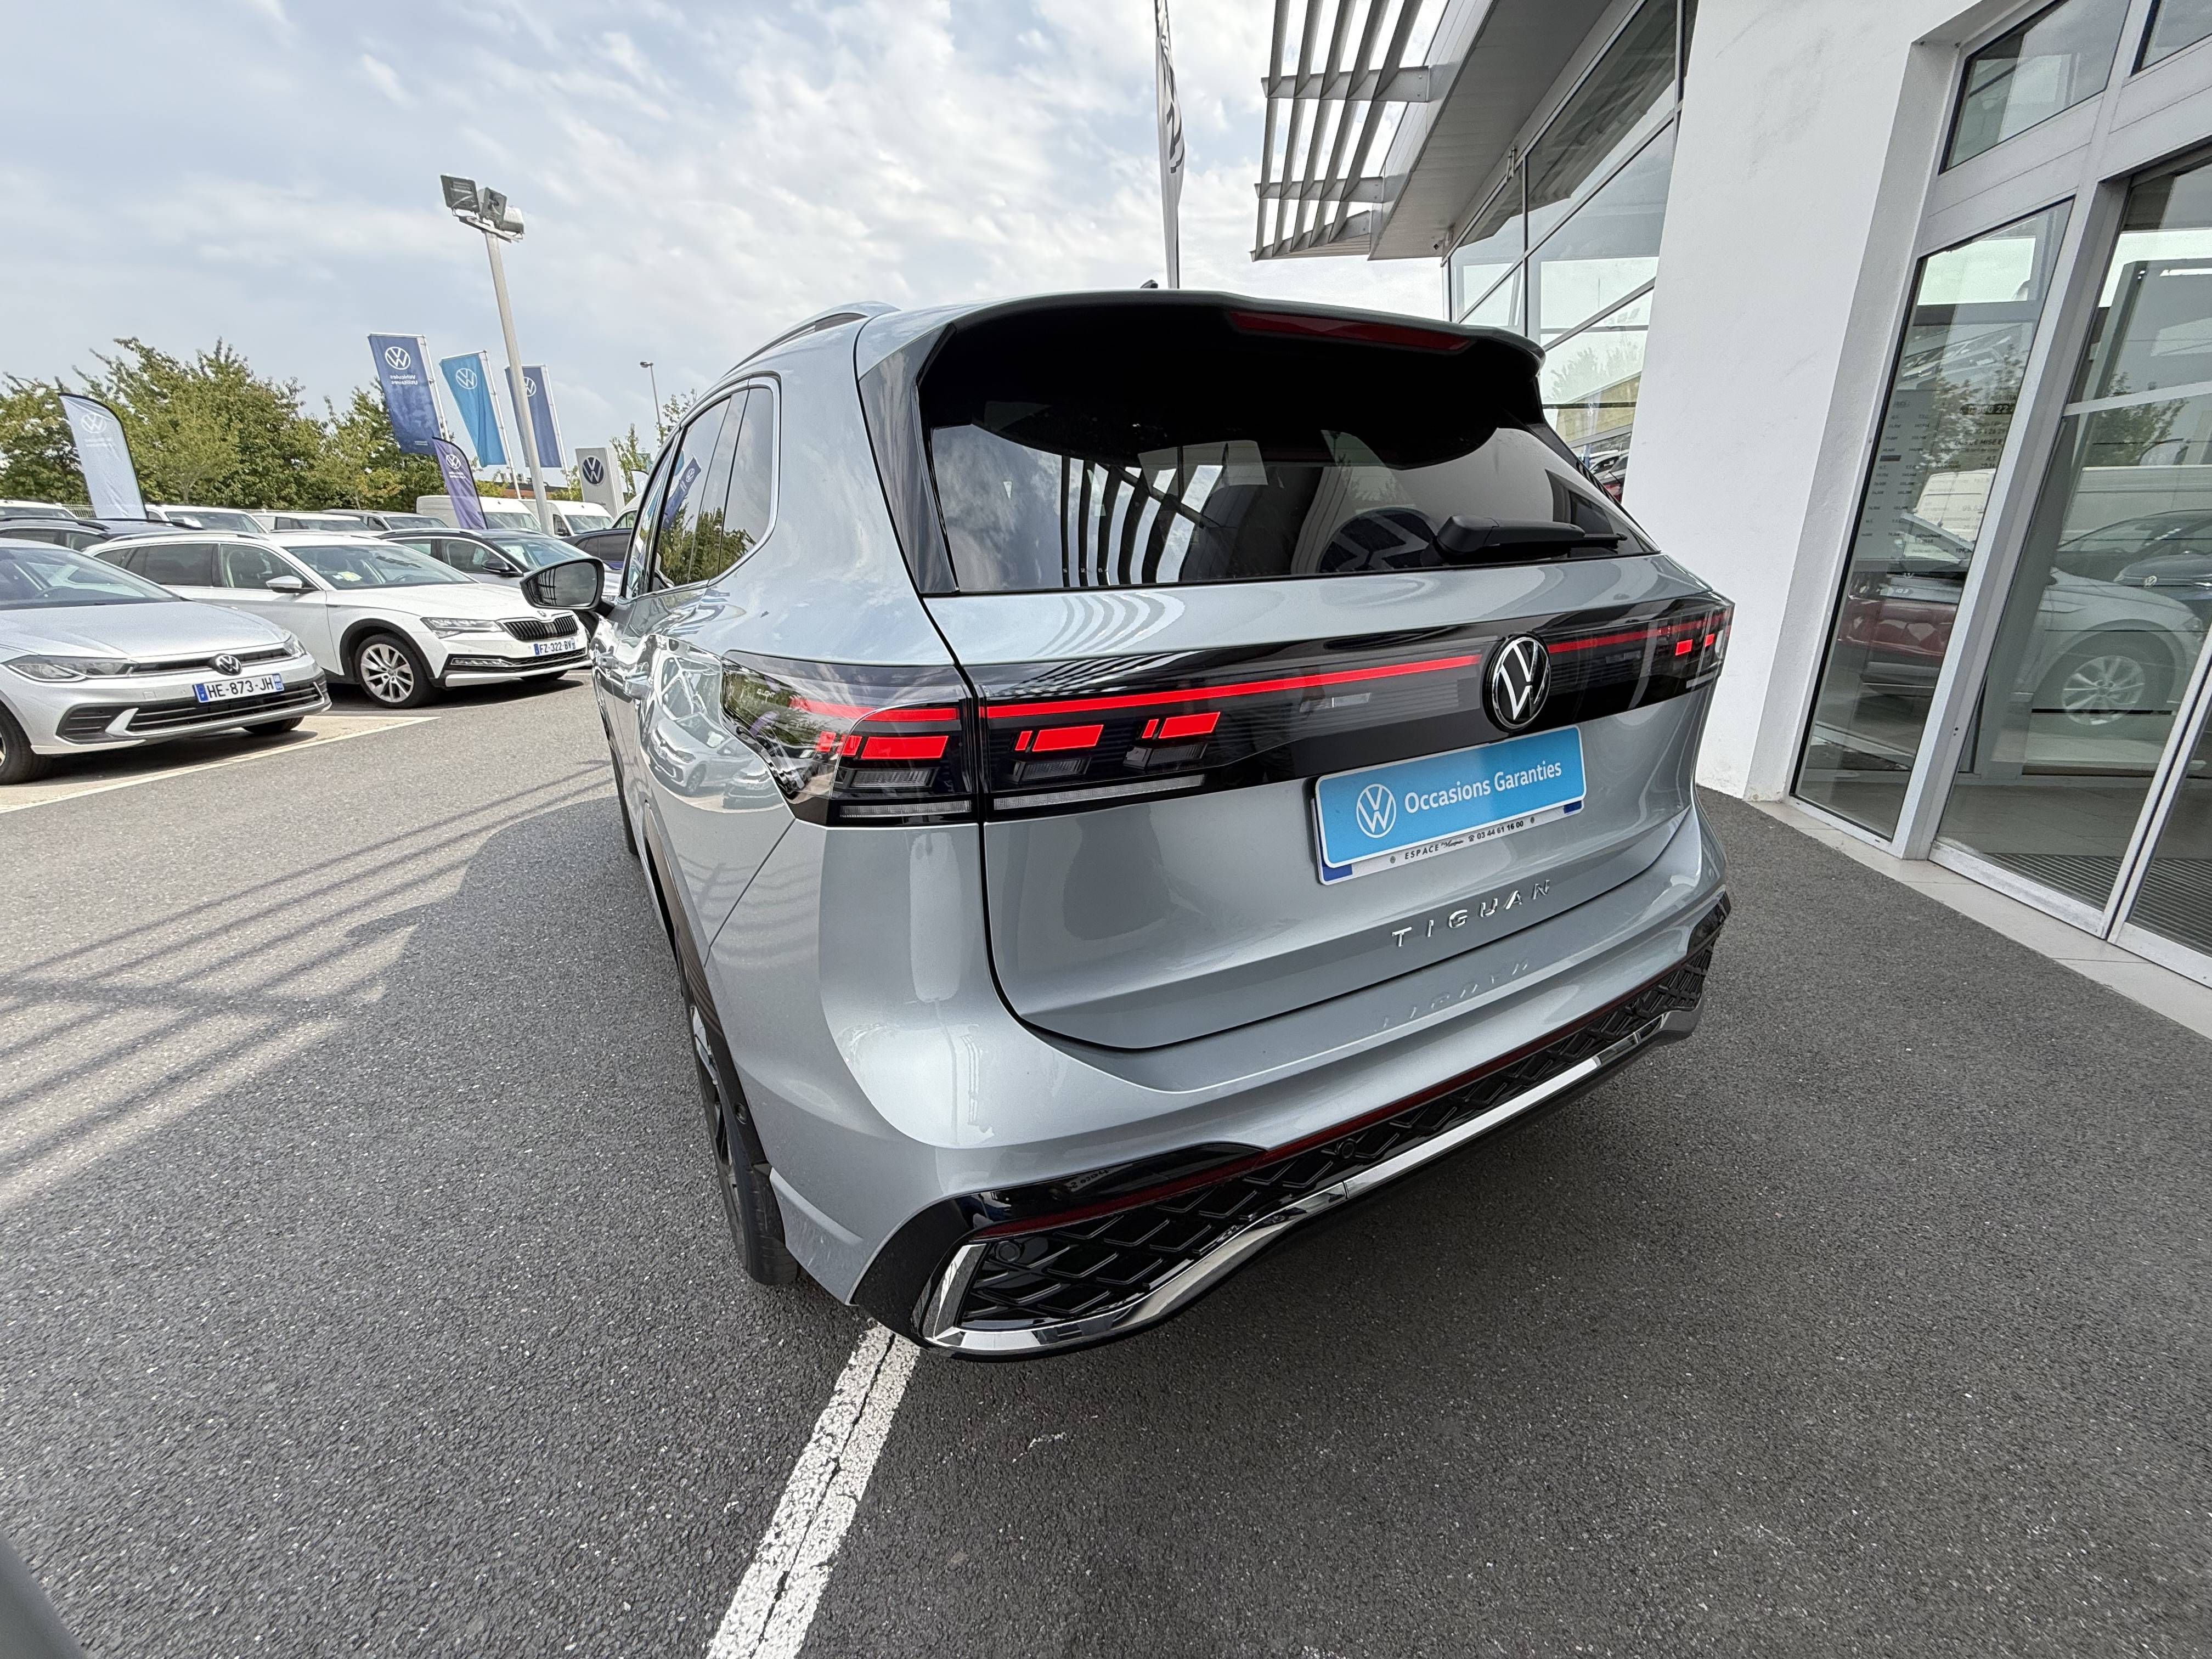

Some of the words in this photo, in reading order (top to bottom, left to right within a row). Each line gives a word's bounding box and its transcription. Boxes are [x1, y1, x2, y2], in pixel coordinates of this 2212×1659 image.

[385, 346, 411, 370] VW
[456, 368, 478, 390] VW
[582, 455, 605, 487] VW
[216, 654, 242, 676] VW
[207, 676, 274, 699] HE-873-JH
[1492, 636, 1551, 729] VW
[1356, 783, 1397, 839] VW
[1404, 778, 1491, 814] Occasions
[1494, 760, 1562, 792] Garanties
[1404, 844, 1439, 860] ESPACE
[1477, 832, 1486, 840] 03
[1487, 828, 1496, 837] 44
[1497, 826, 1505, 834] 61
[1507, 823, 1515, 832] 16
[1516, 820, 1524, 829] 00
[1391, 879, 1550, 947] TIGUAN
